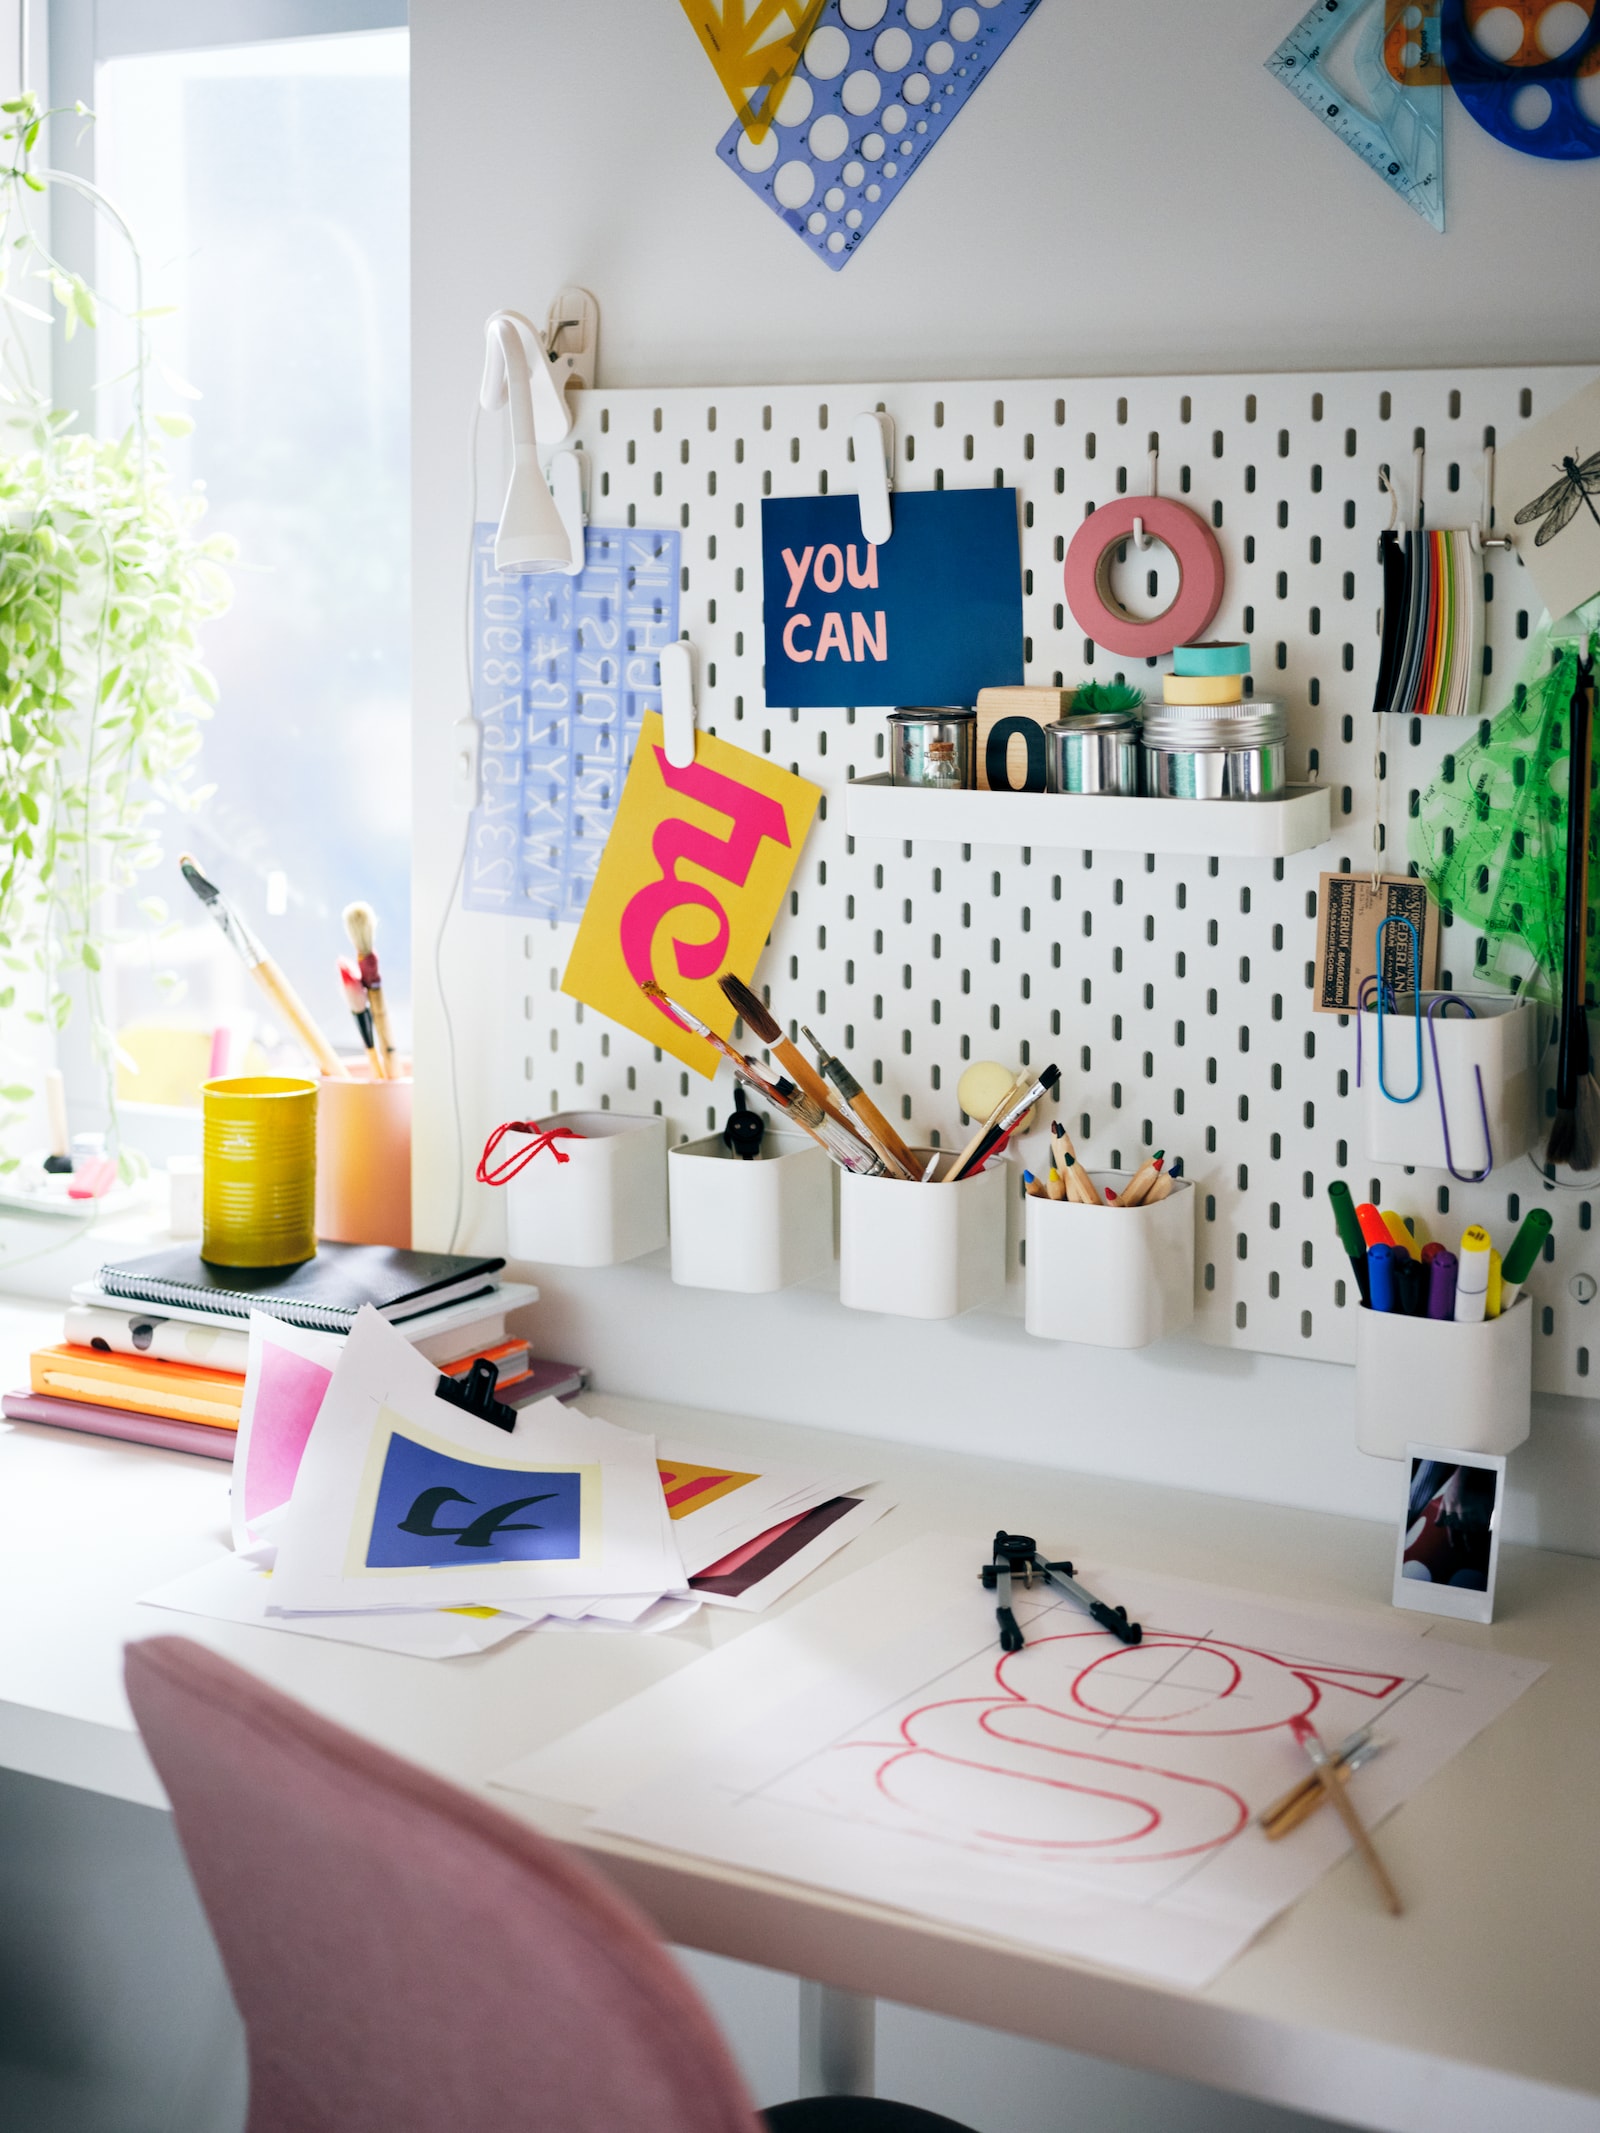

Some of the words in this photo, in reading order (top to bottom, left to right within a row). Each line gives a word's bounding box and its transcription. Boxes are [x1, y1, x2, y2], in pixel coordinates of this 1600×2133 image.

[782, 610, 888, 663] CAN
[1338, 884, 1352, 948] BAGAGERUIM
[1388, 890, 1397, 947] AMSTRDAM
[1335, 952, 1346, 1004] BAGGAGEHOLD
